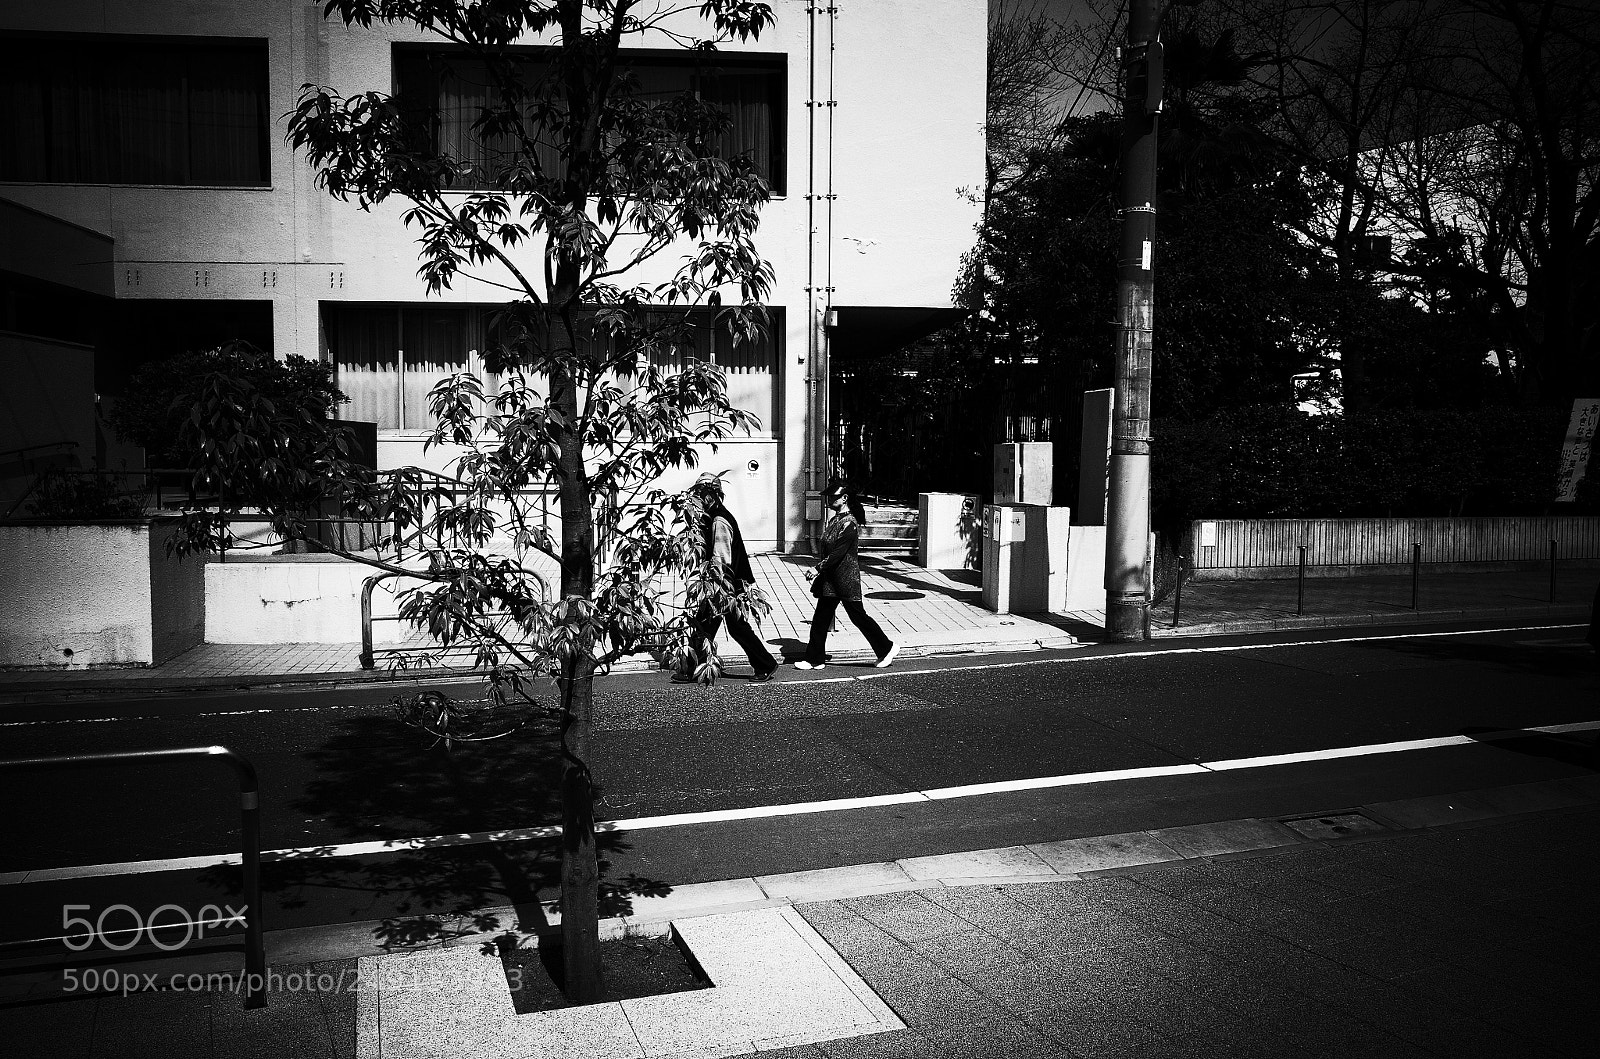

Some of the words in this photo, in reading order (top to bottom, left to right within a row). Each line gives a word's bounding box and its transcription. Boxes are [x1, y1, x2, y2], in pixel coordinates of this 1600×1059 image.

[1578, 403, 1600, 463] あいさつは
